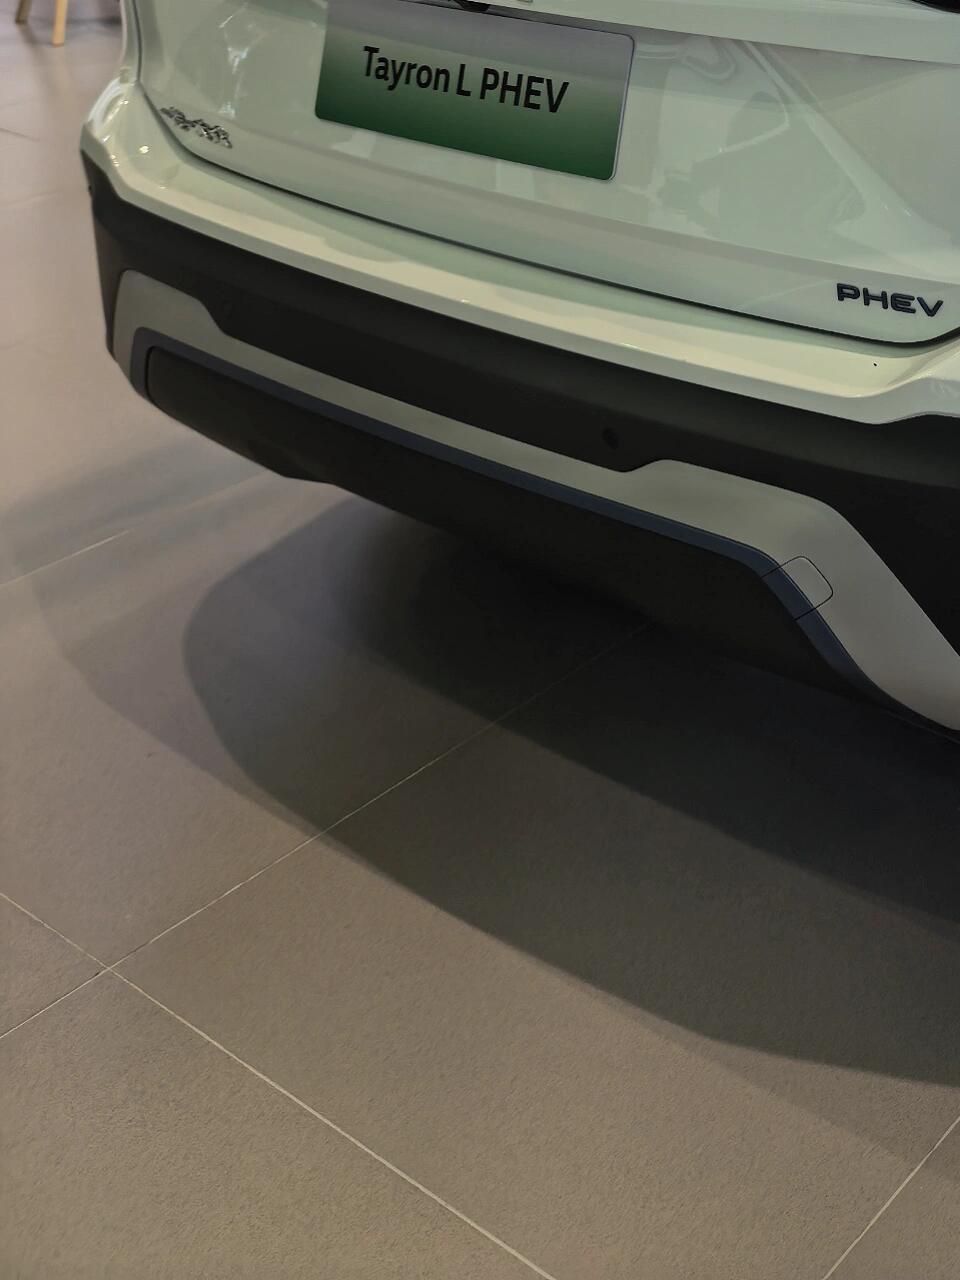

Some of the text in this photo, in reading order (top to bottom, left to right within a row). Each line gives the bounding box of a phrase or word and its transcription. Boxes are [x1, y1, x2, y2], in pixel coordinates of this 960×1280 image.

[363, 45, 570, 114] Tayron L PHEV
[835, 282, 945, 318] PHEV
